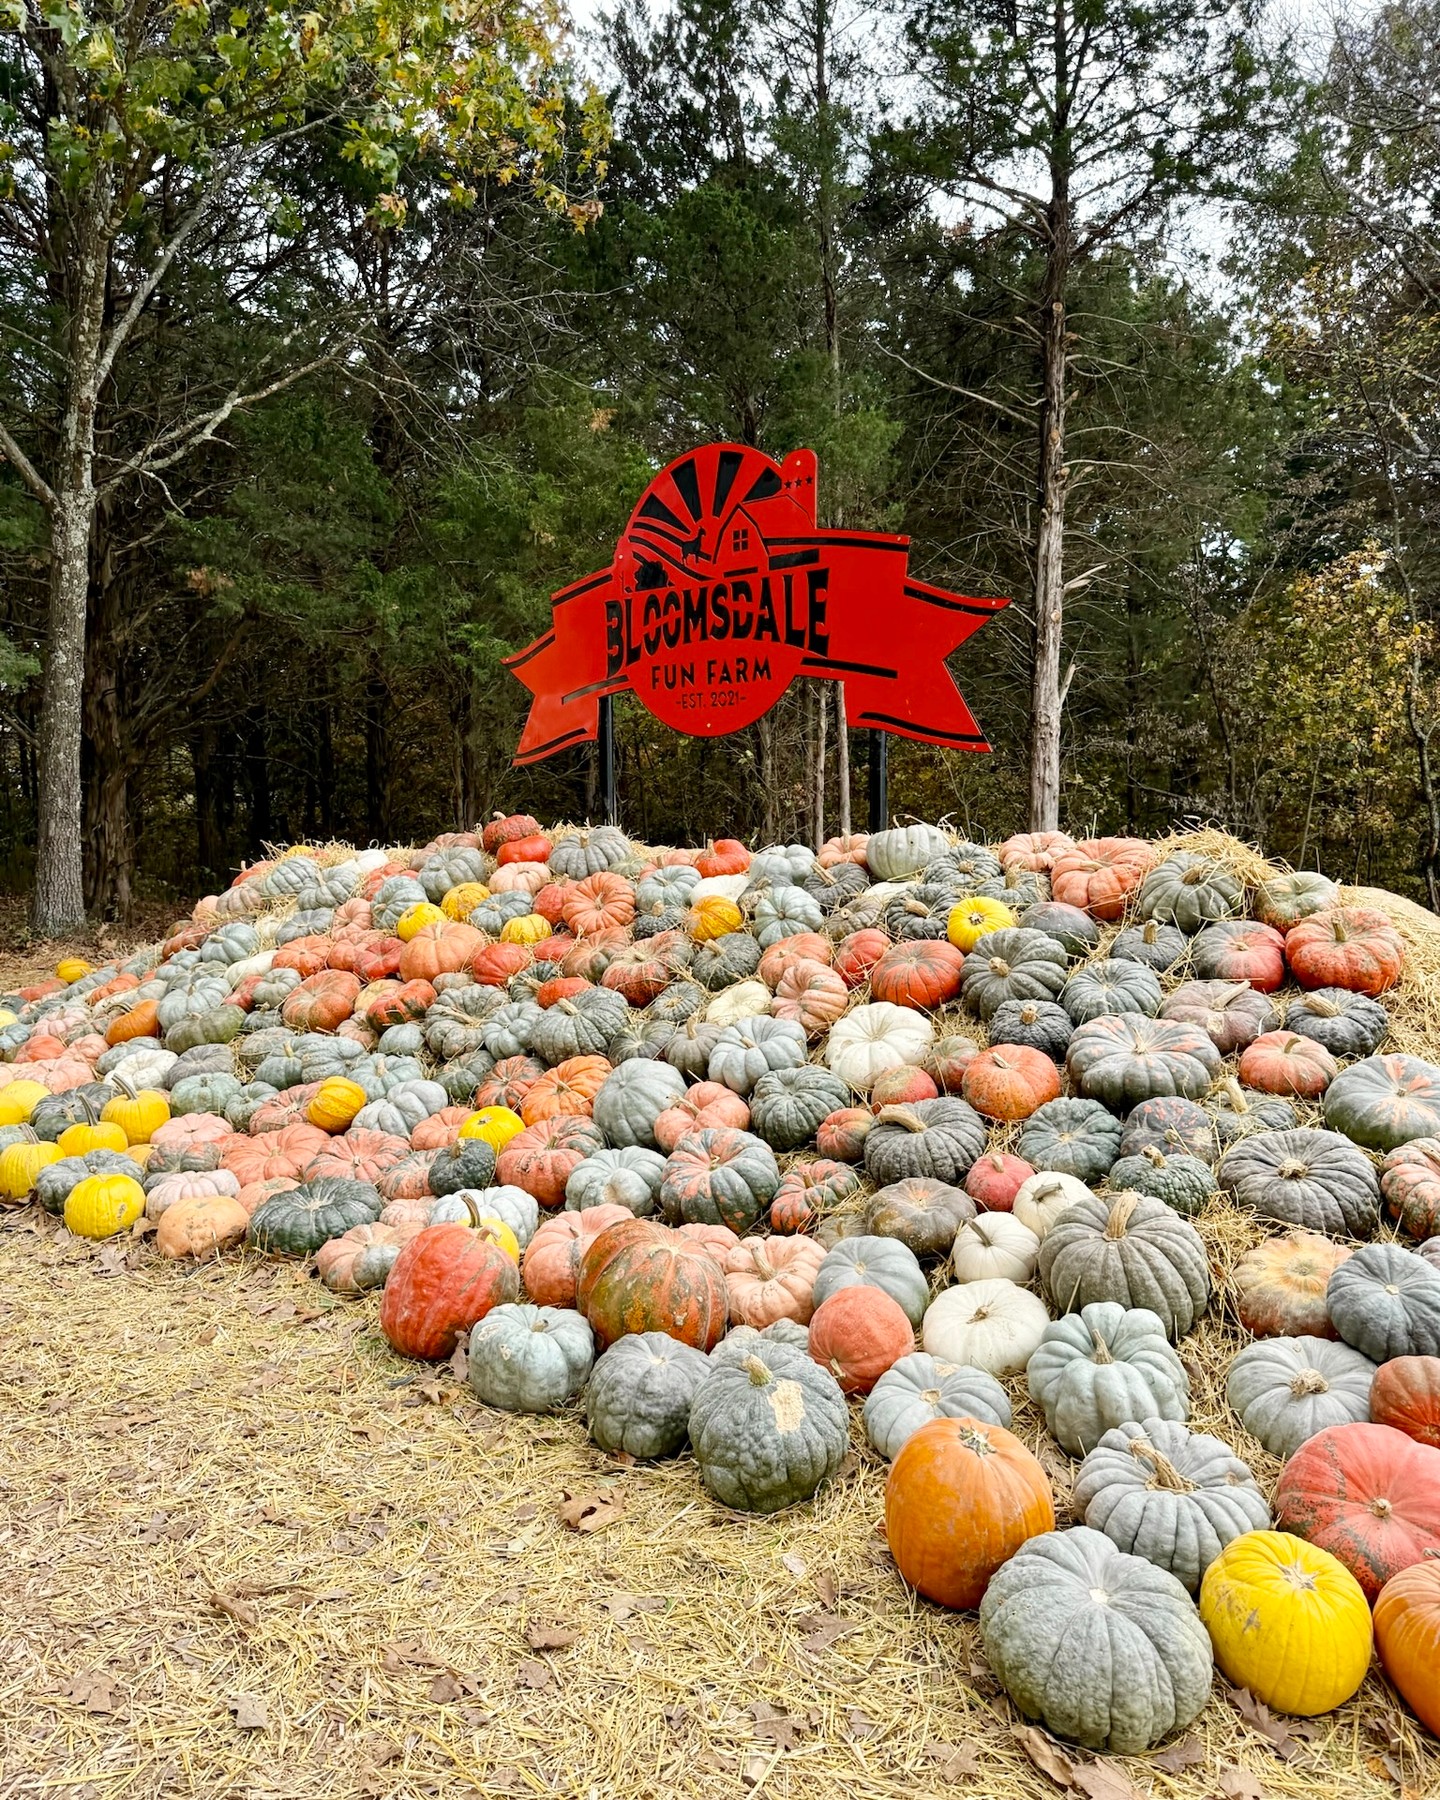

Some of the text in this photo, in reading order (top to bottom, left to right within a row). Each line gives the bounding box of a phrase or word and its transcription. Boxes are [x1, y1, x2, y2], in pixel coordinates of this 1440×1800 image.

[605, 569, 829, 679] BLOOMSDALE
[651, 657, 771, 690] FUN FARM
